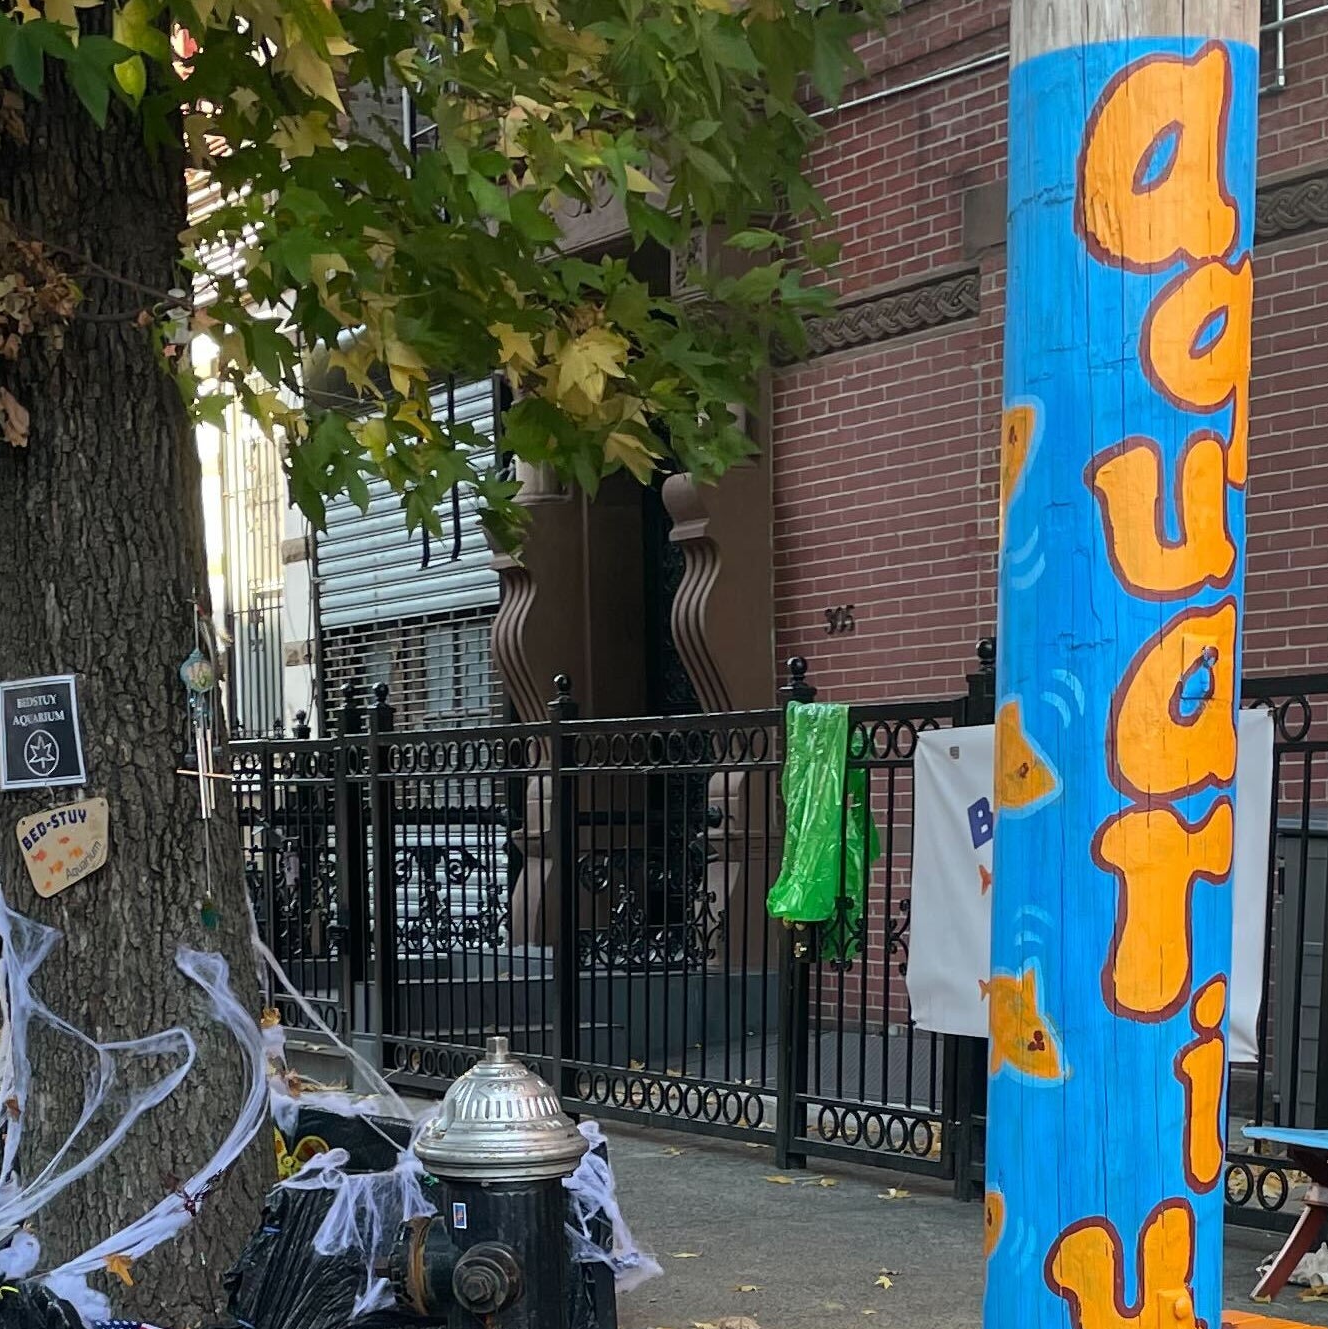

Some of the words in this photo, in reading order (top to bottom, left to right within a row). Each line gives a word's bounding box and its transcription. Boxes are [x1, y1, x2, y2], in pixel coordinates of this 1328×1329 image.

[12, 709, 66, 727] AQUARIUM
[21, 808, 88, 852] BED-STUY
[65, 839, 102, 882] Aquarium
